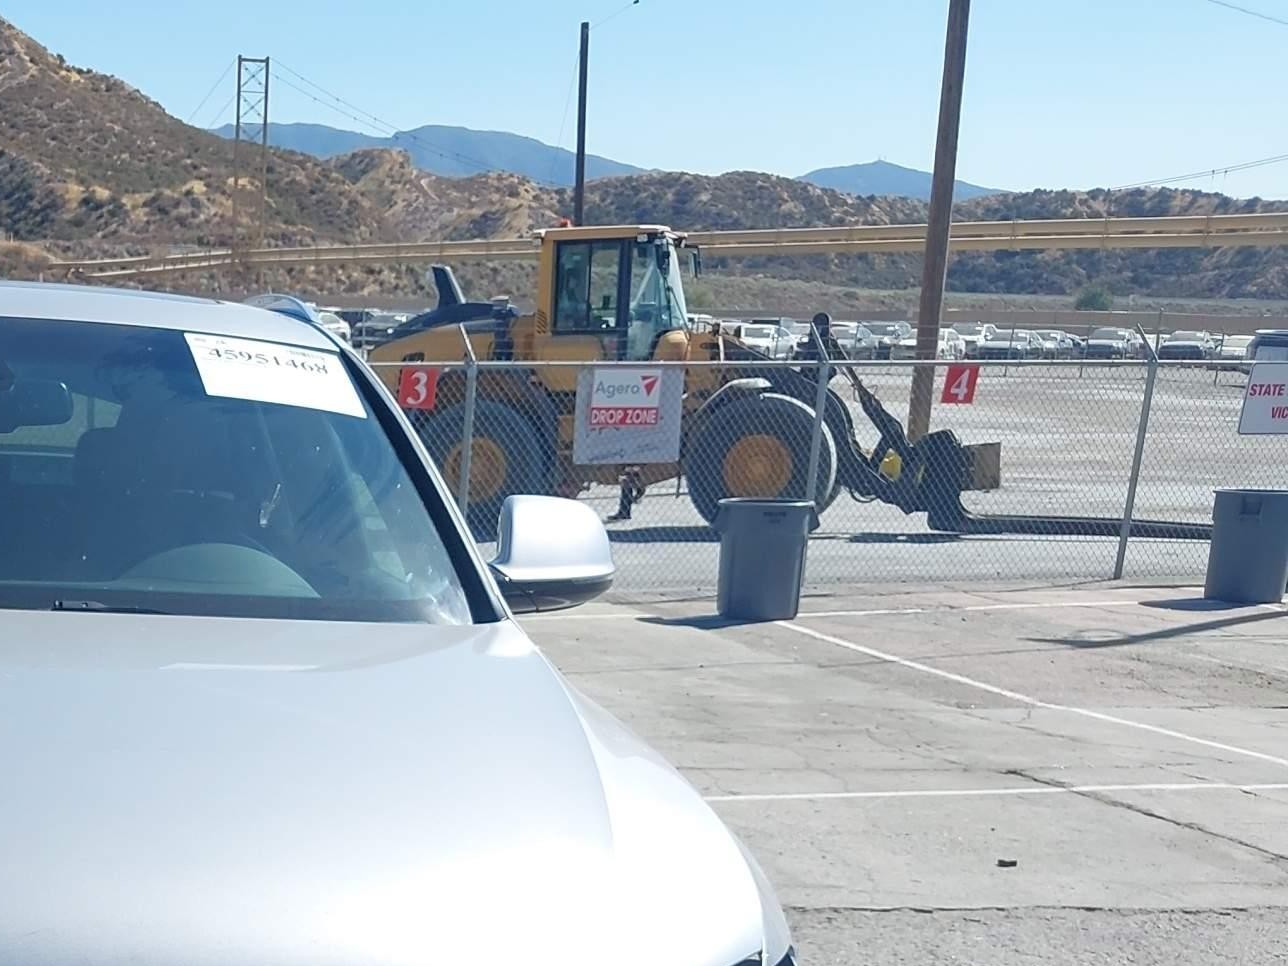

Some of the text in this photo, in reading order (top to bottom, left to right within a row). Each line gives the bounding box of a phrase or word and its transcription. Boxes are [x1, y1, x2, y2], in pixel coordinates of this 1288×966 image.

[208, 347, 329, 375] 45951468
[405, 371, 428, 405] 3
[595, 380, 641, 399] Agero
[950, 368, 970, 401] 4
[1249, 383, 1286, 397] STATE
[591, 409, 657, 424] DROP ZONE
